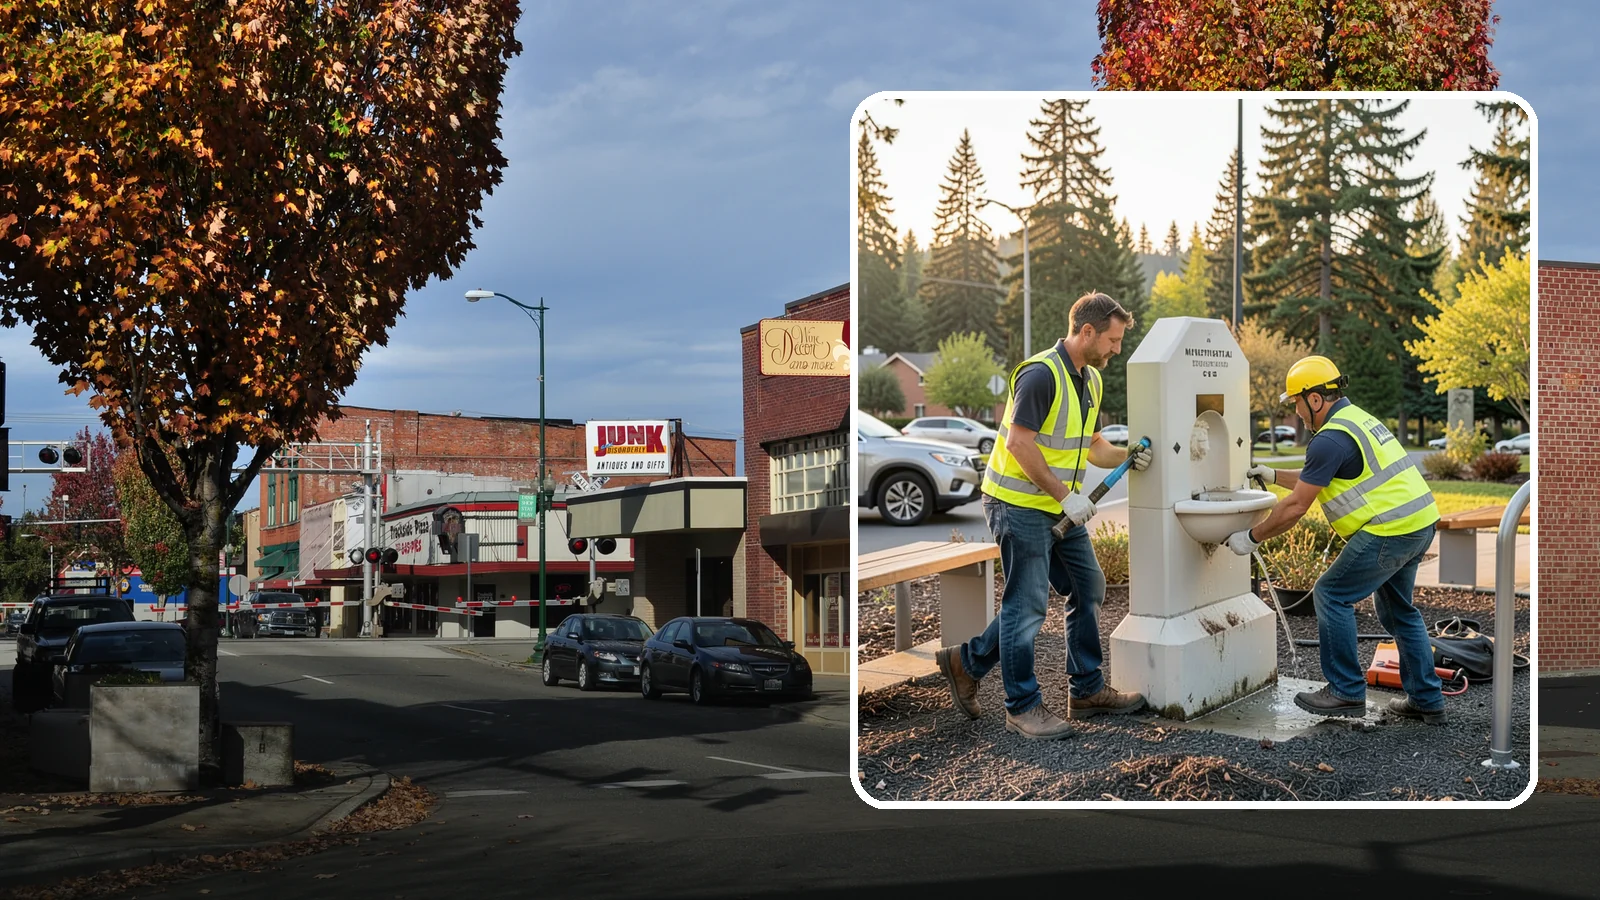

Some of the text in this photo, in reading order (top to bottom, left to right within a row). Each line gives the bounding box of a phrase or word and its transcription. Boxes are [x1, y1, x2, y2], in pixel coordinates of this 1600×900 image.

[595, 425, 665, 457] JUNK
[607, 446, 646, 454] DISORDERLY
[597, 460, 665, 470] ANTIQUES AND GIFTS
[590, 475, 608, 491] SING
[414, 519, 429, 534] Pizza
